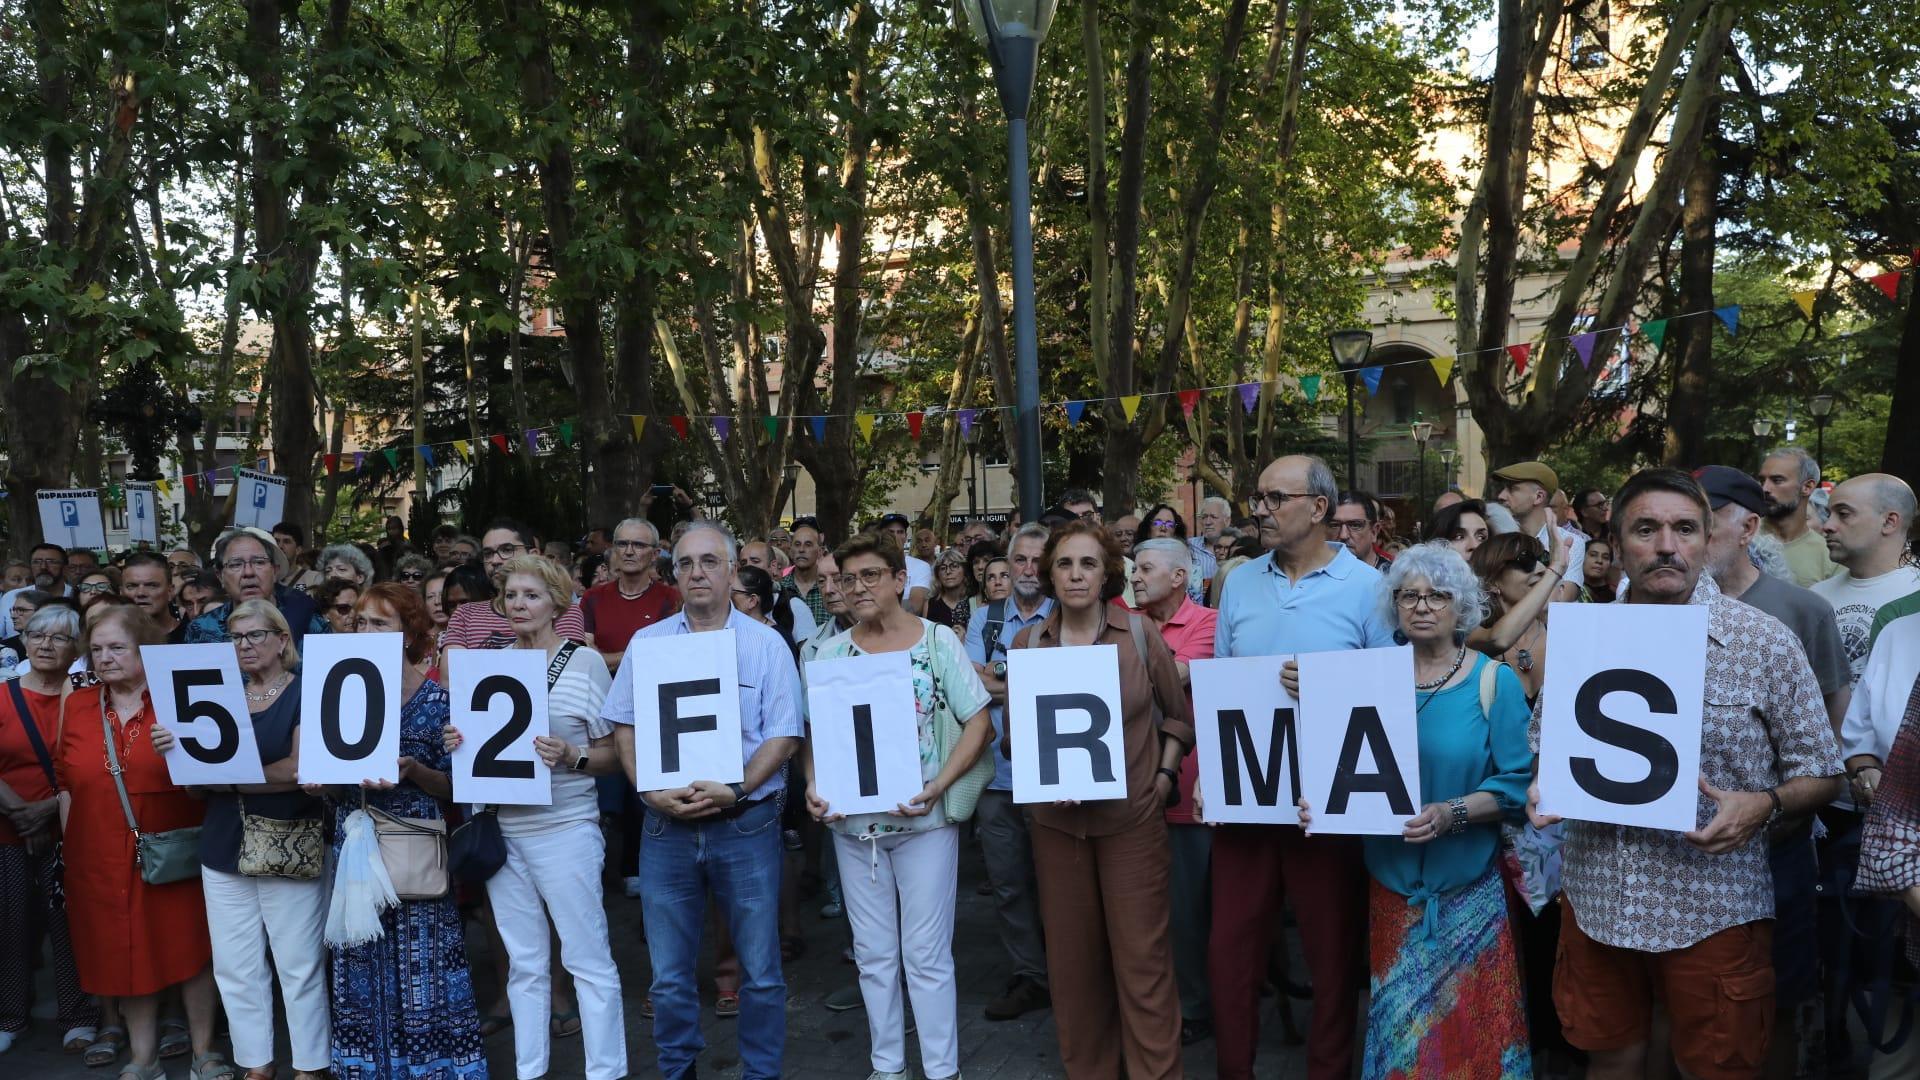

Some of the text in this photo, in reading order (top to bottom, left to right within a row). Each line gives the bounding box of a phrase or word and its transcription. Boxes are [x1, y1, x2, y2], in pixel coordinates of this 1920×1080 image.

[62, 502, 75, 522] P
[708, 495, 721, 504] WC
[320, 658, 386, 760] 0
[547, 650, 573, 684] BIMBA
[172, 669, 239, 764] 5
[470, 675, 536, 779] 2
[657, 678, 721, 773] F
[853, 704, 879, 796] I
[1035, 694, 1117, 786] R
[1217, 708, 1300, 807] M
[1325, 706, 1416, 816] A
[1569, 669, 1679, 805] S
